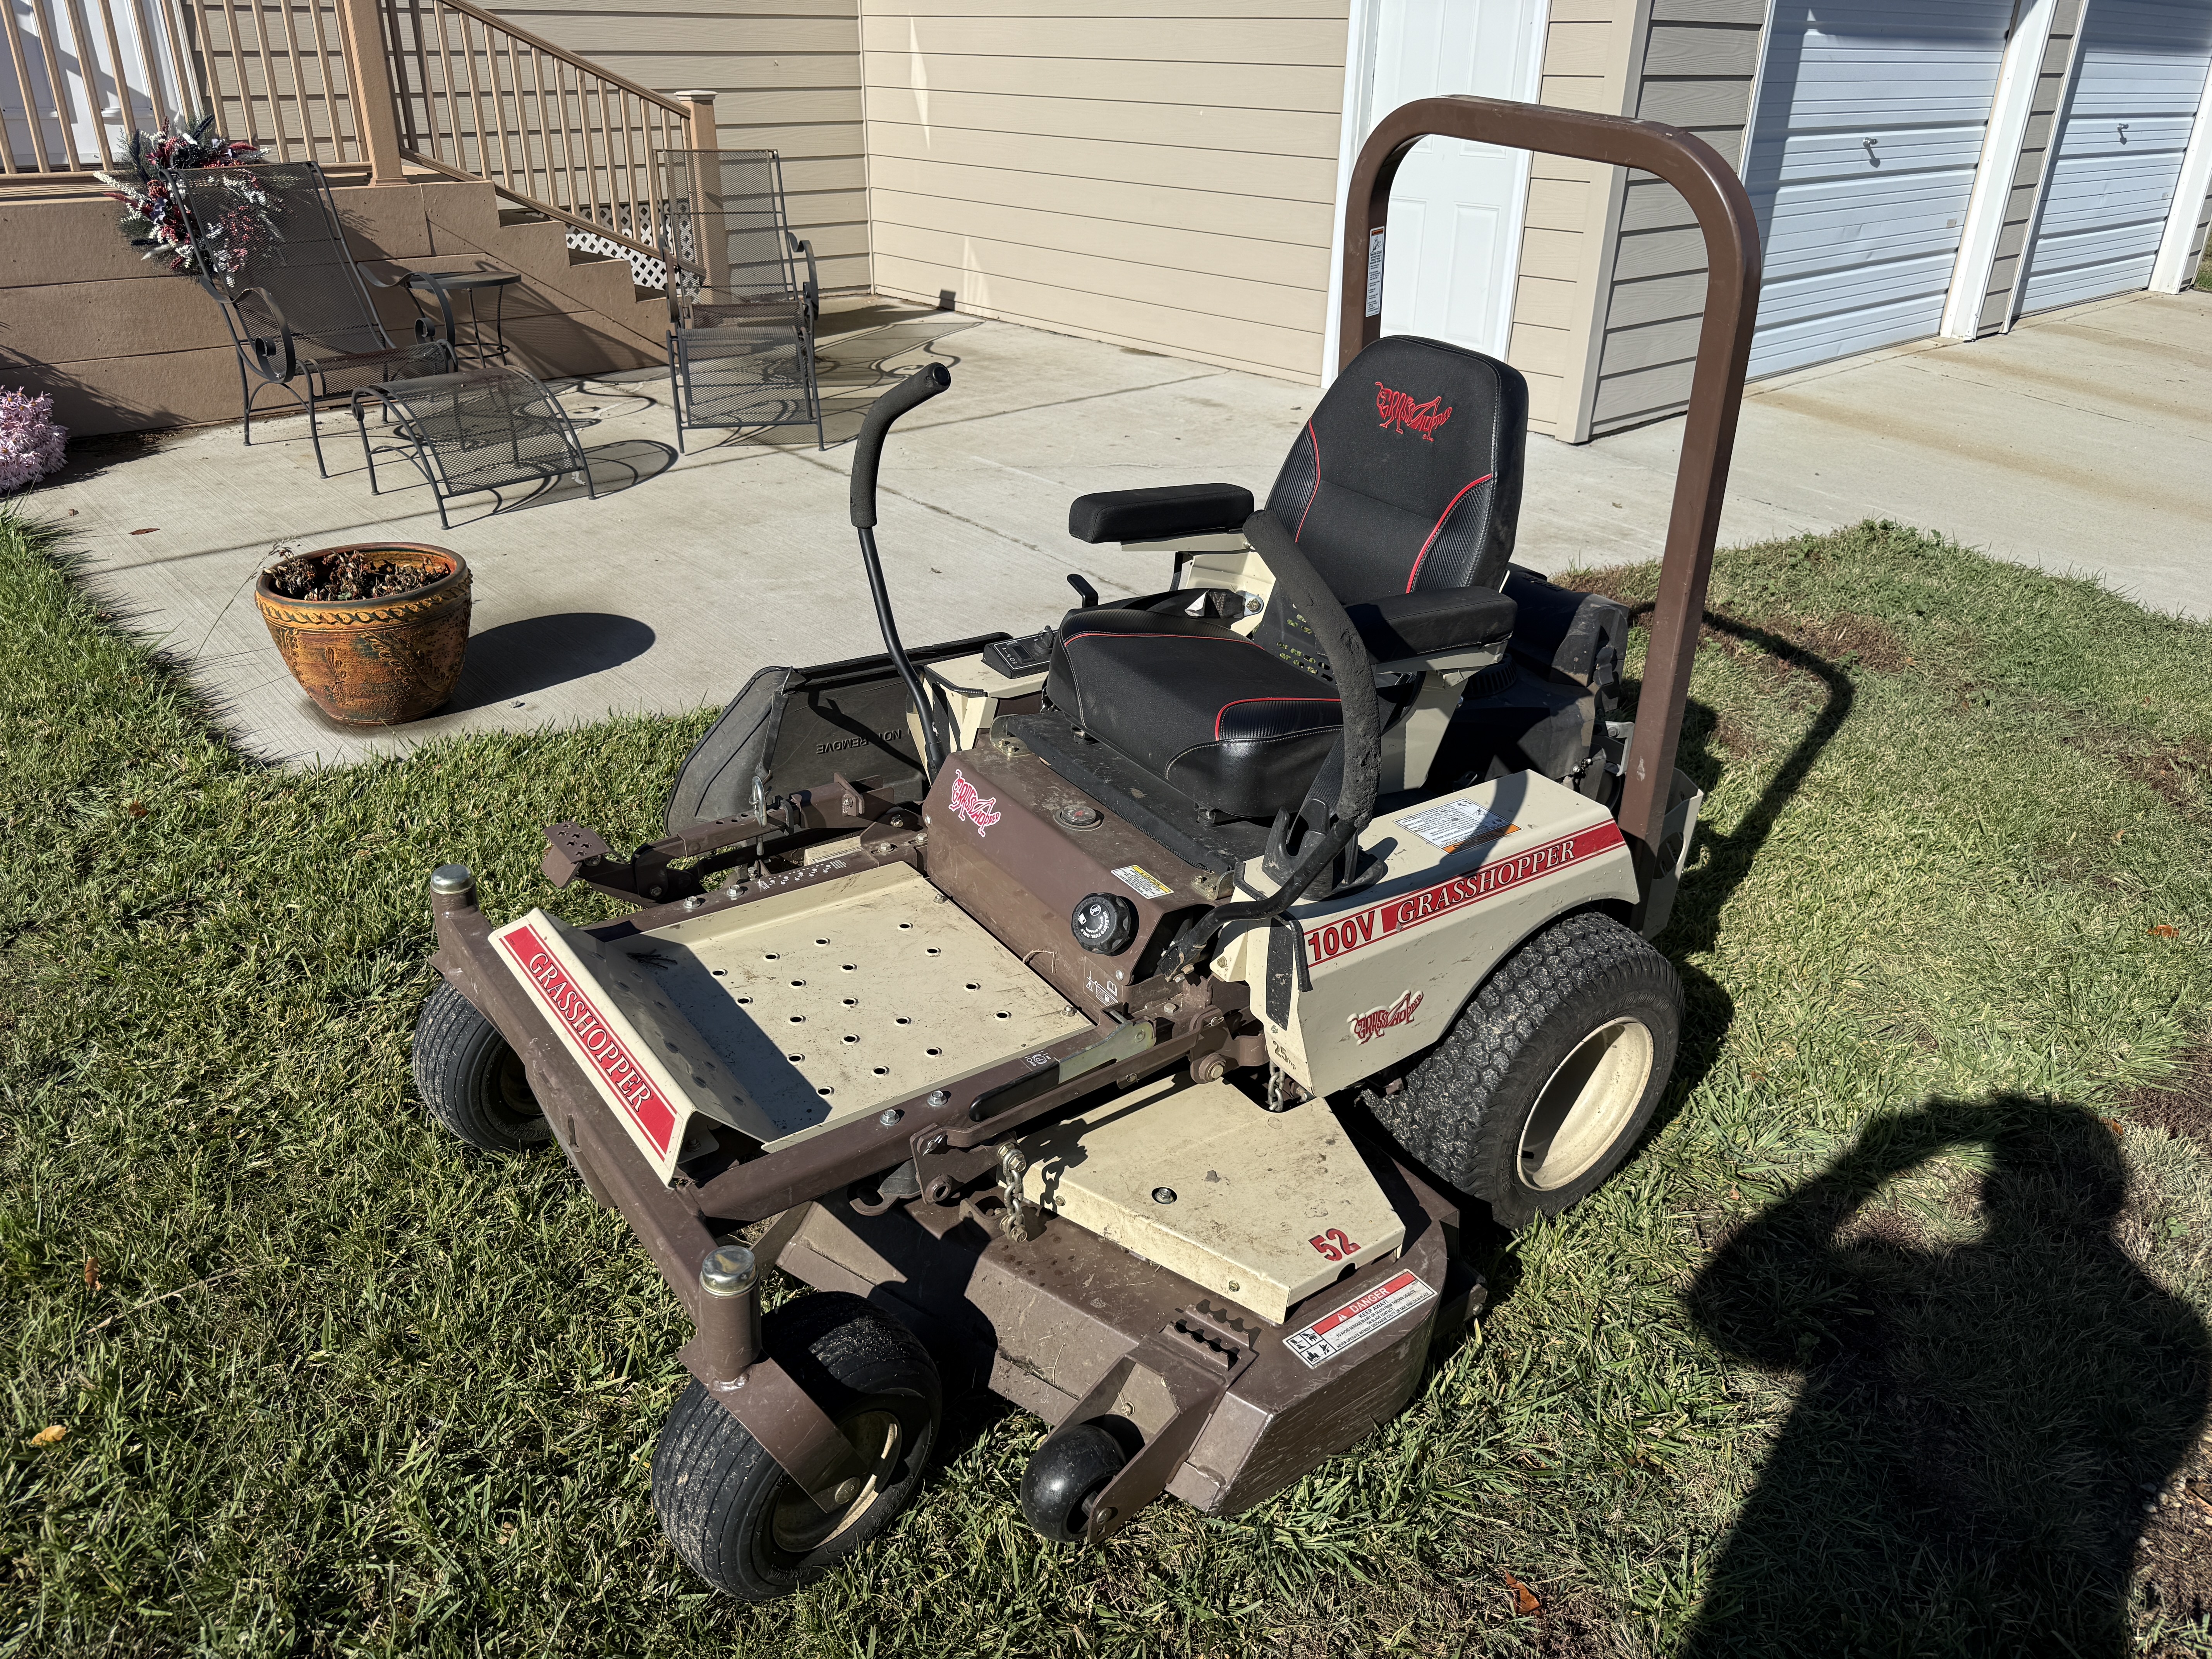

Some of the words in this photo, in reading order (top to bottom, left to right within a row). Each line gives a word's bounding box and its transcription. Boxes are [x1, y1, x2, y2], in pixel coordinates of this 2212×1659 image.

[816, 737, 869, 754] REMOVE
[950, 773, 1001, 836] GRASSHOPPER
[1308, 910, 1376, 962] 100V
[1397, 839, 1575, 924] GRASSHOPPER
[529, 951, 653, 1112] GRASSHOPPER
[1352, 992, 1424, 1042] GRASSHOPPER
[1503, 1127, 1522, 1193] SUPER
[1519, 1057, 1557, 1118] TURF
[1308, 1228, 1361, 1261] 52
[1349, 1287, 1390, 1313] DANGER
[1358, 1308, 1372, 1318] KEEP
[1372, 1299, 1388, 1310] AWAY!
